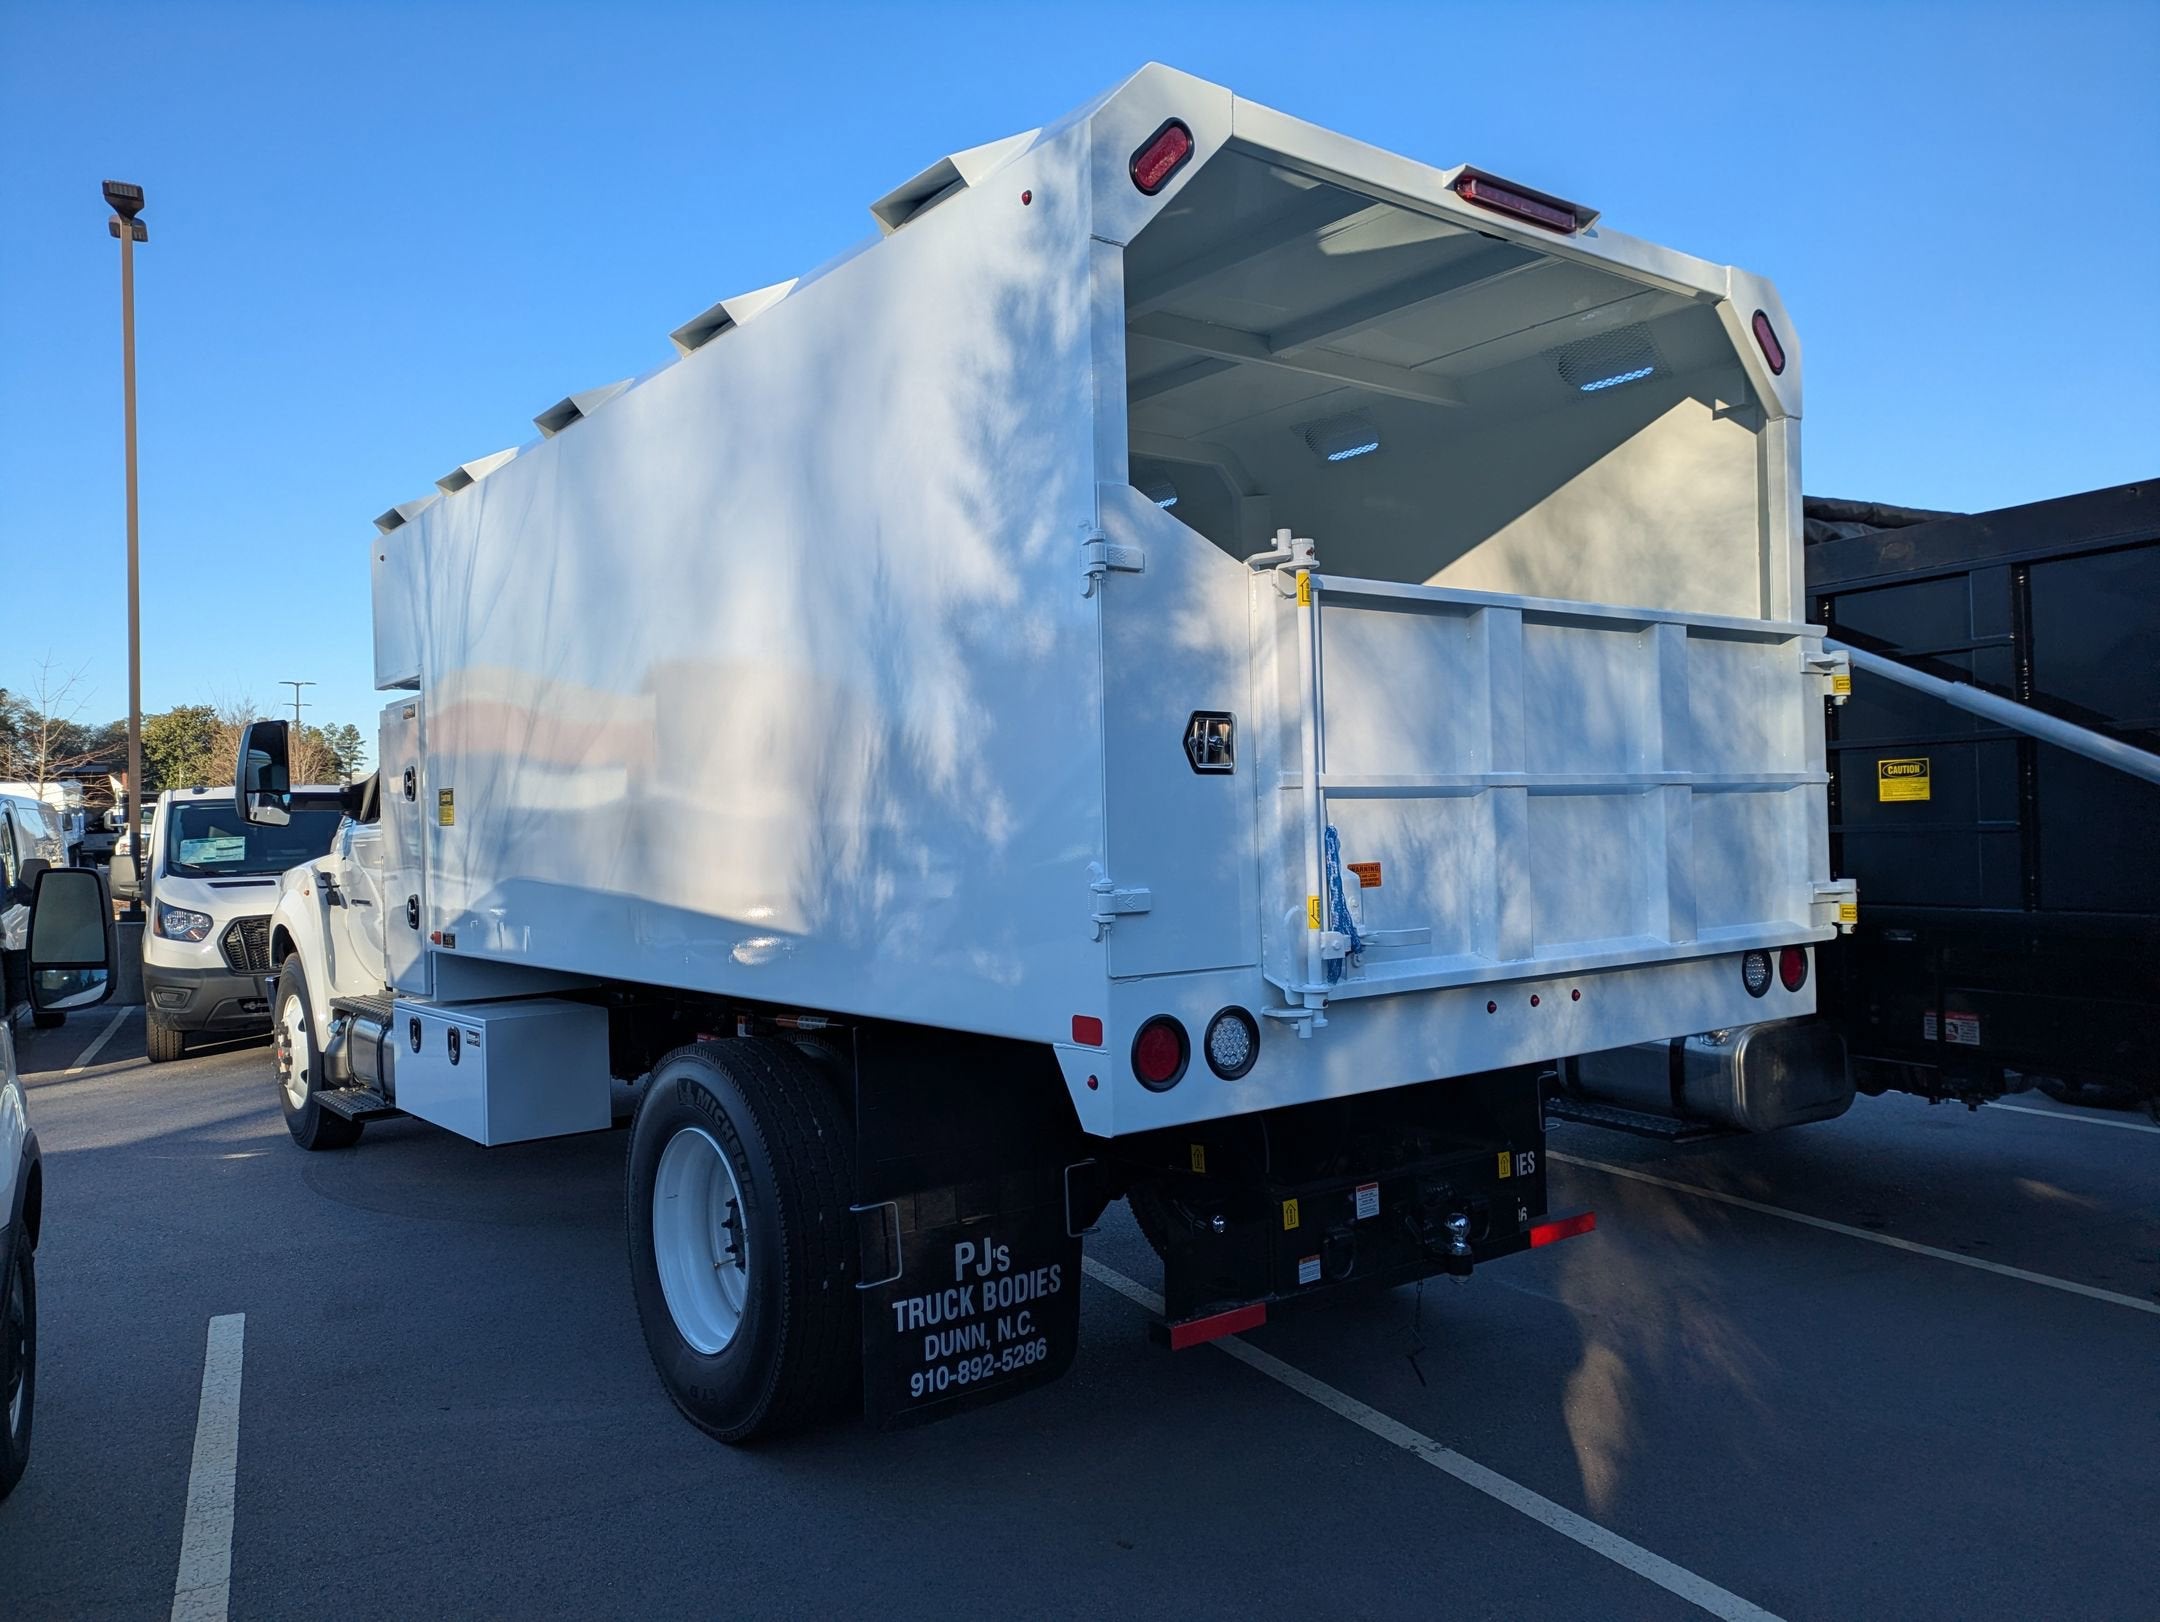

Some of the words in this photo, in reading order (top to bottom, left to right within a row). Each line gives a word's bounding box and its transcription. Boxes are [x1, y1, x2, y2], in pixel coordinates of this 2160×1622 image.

[1887, 764, 1920, 775] CAUTION
[891, 1284, 976, 1333] TRUCK
[982, 1263, 1062, 1313] BODIES
[924, 1322, 991, 1362] DUNN,
[997, 1310, 1036, 1343] N.C.
[909, 1336, 1048, 1398] 910-892-5286
